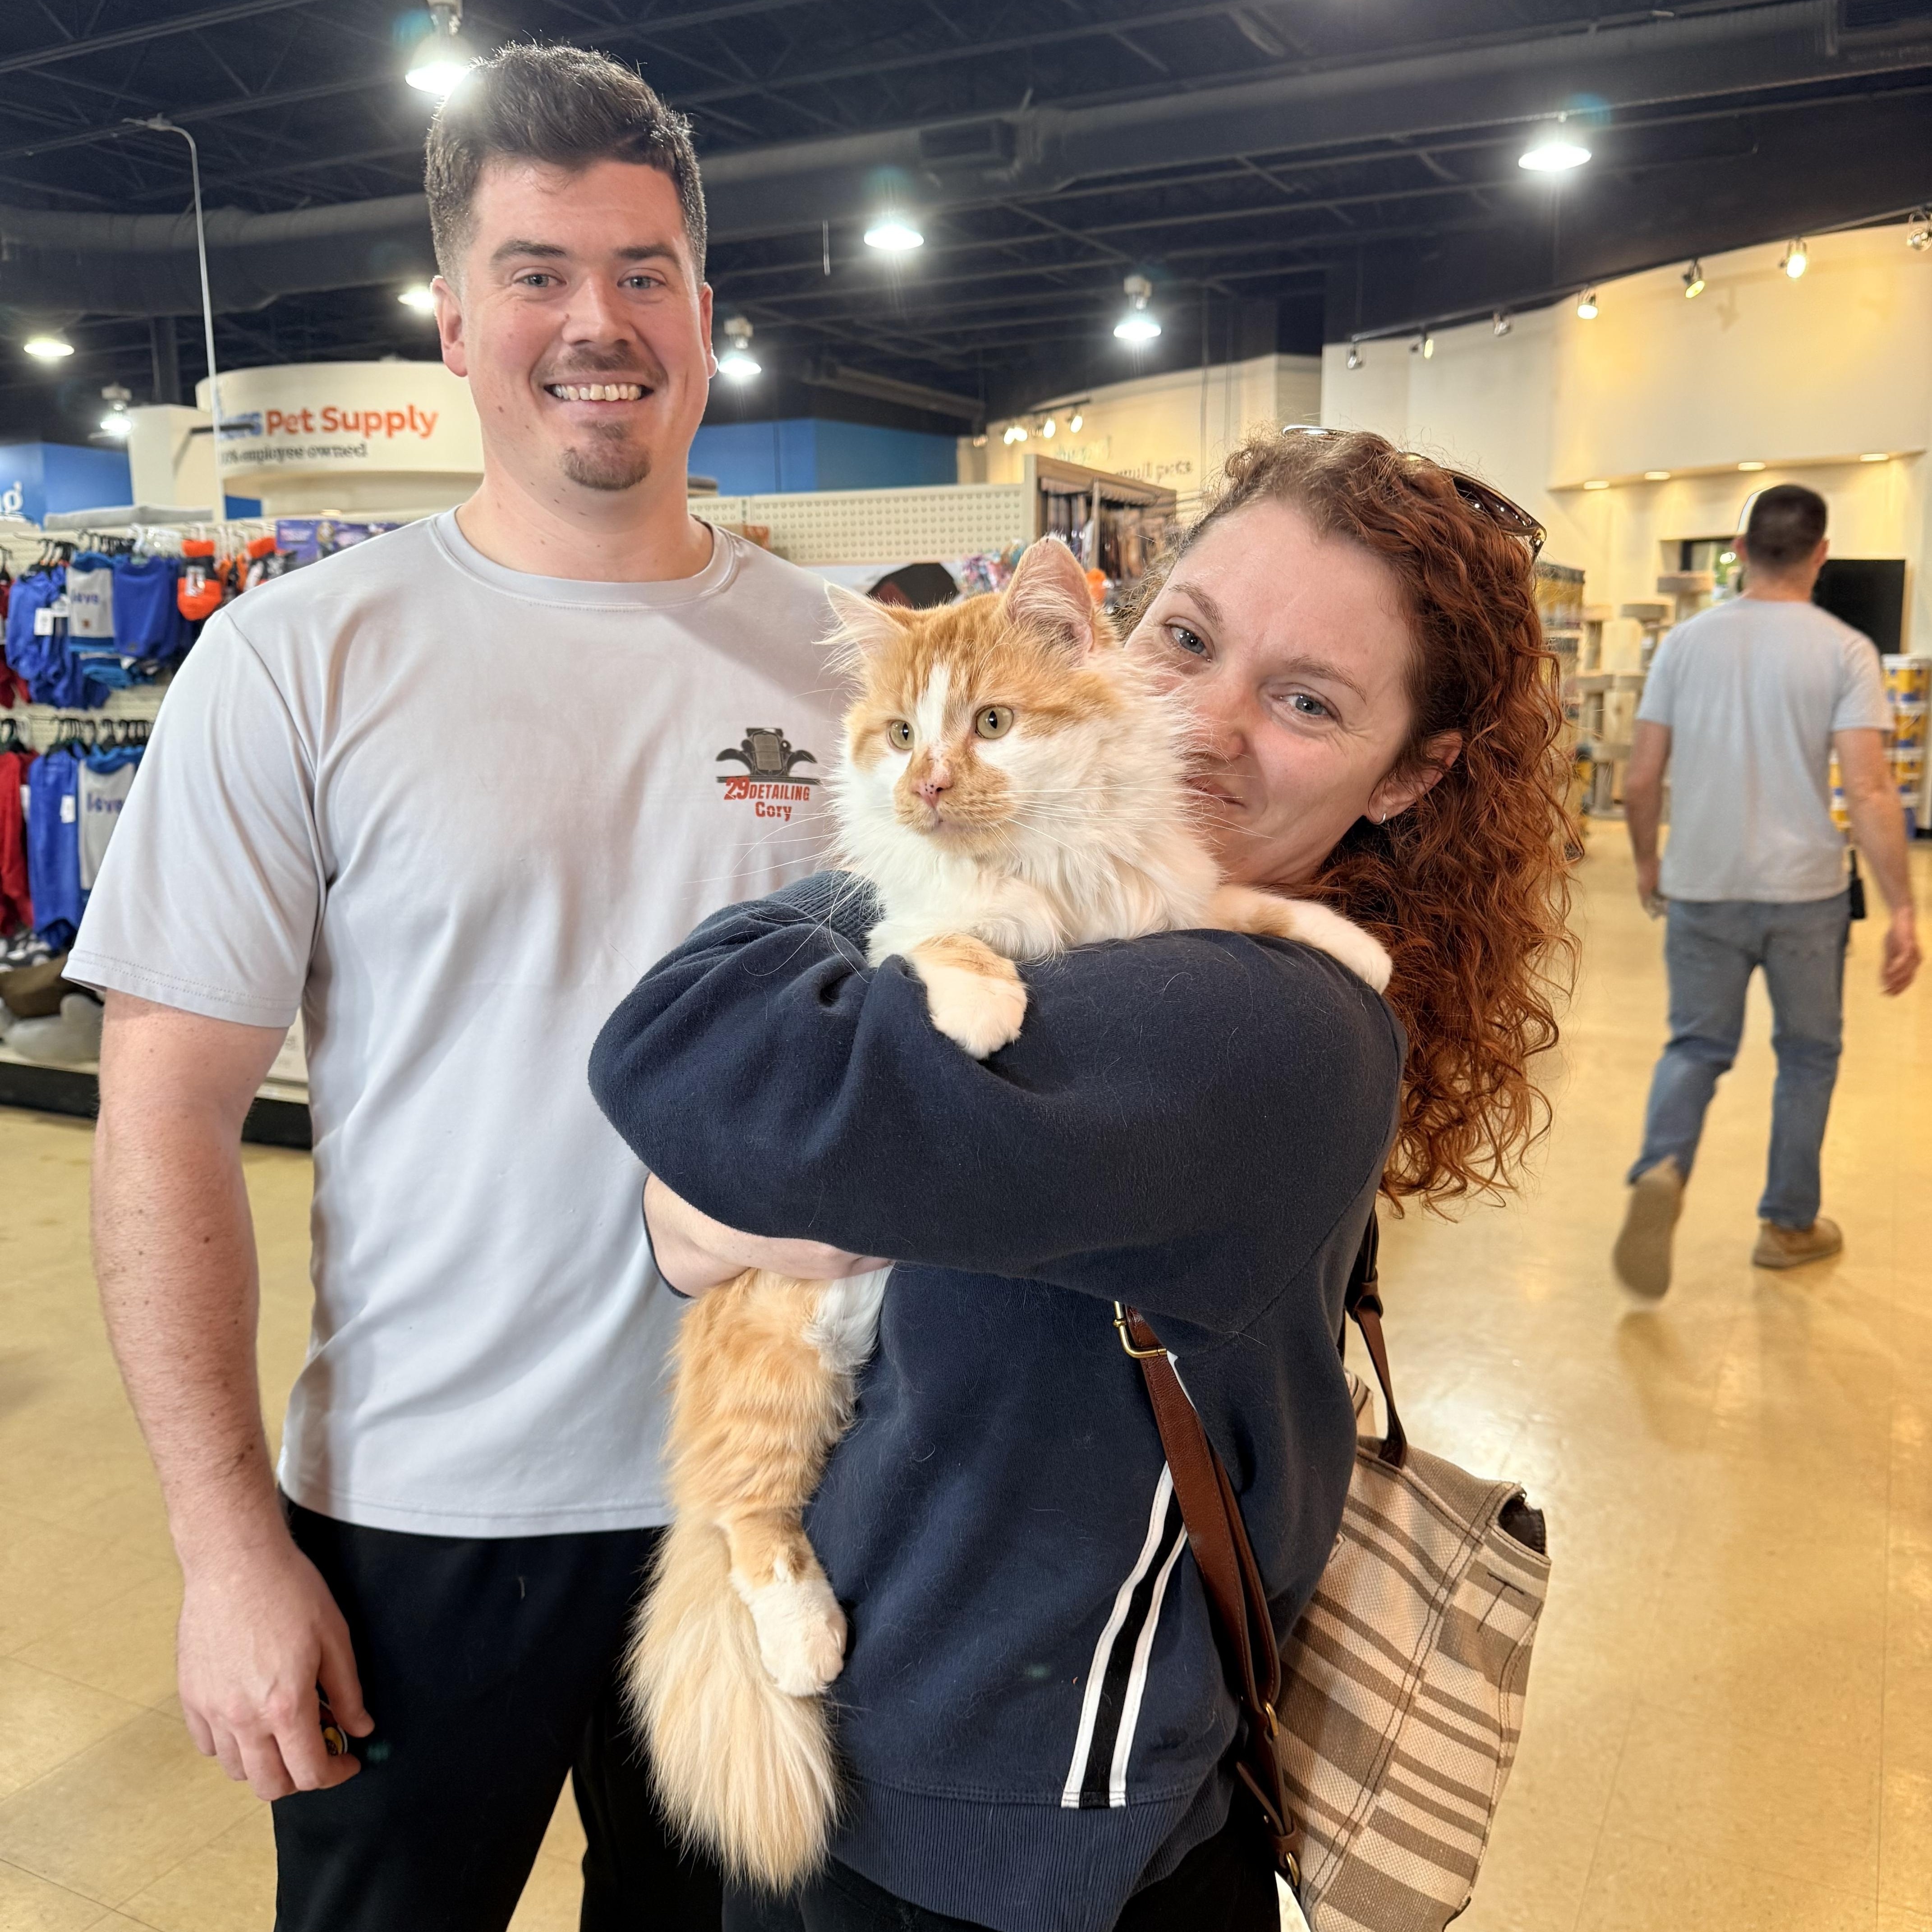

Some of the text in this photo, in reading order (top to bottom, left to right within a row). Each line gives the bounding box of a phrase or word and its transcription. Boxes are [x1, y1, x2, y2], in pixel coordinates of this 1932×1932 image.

[265, 407, 314, 435] Pet
[320, 403, 439, 440] Supply
[307, 441, 368, 458] owned
[755, 801, 792, 822] Cory
